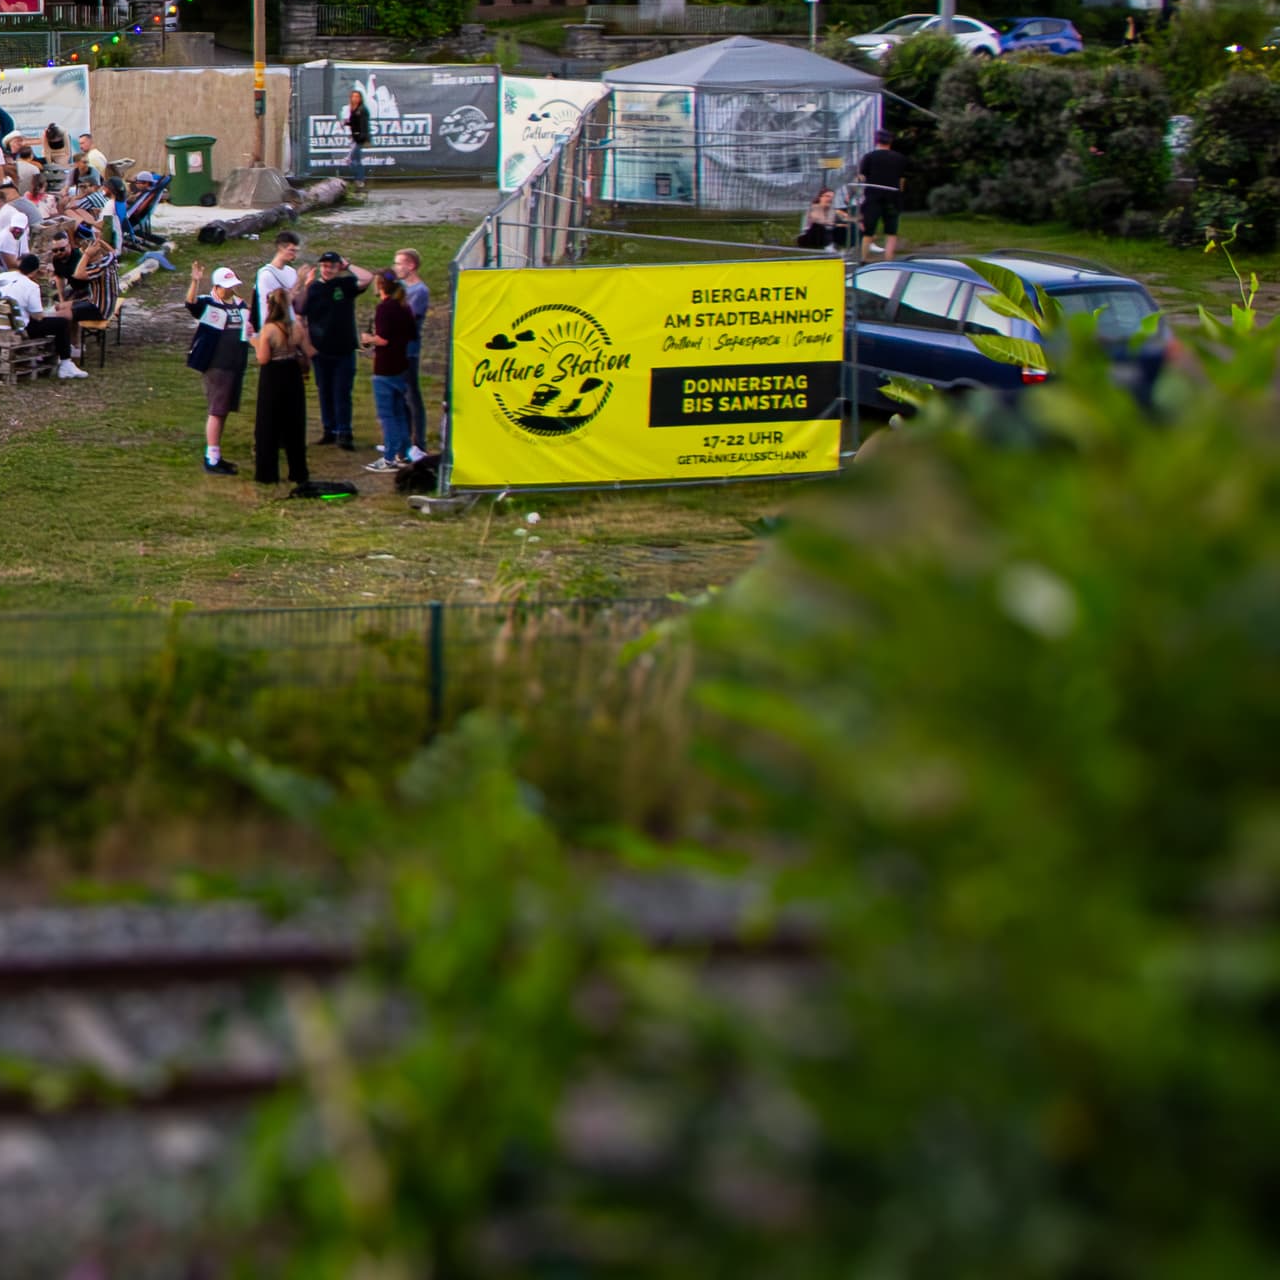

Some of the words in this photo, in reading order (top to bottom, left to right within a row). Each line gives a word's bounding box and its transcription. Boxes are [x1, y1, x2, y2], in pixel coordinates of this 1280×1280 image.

[691, 286, 808, 304] BIERGARTEN
[664, 314, 691, 329] AM
[695, 308, 834, 327] STADTBAHNHOF
[473, 357, 545, 388] Culture
[551, 349, 631, 382] Station
[682, 375, 809, 395] DONNERSTAG
[682, 397, 714, 414] BIS
[719, 393, 809, 412] SAMSTAG
[703, 435, 745, 449] 17-22
[749, 431, 784, 445] UHR
[677, 450, 809, 465] GETRÄNKEAUSSCHANK
